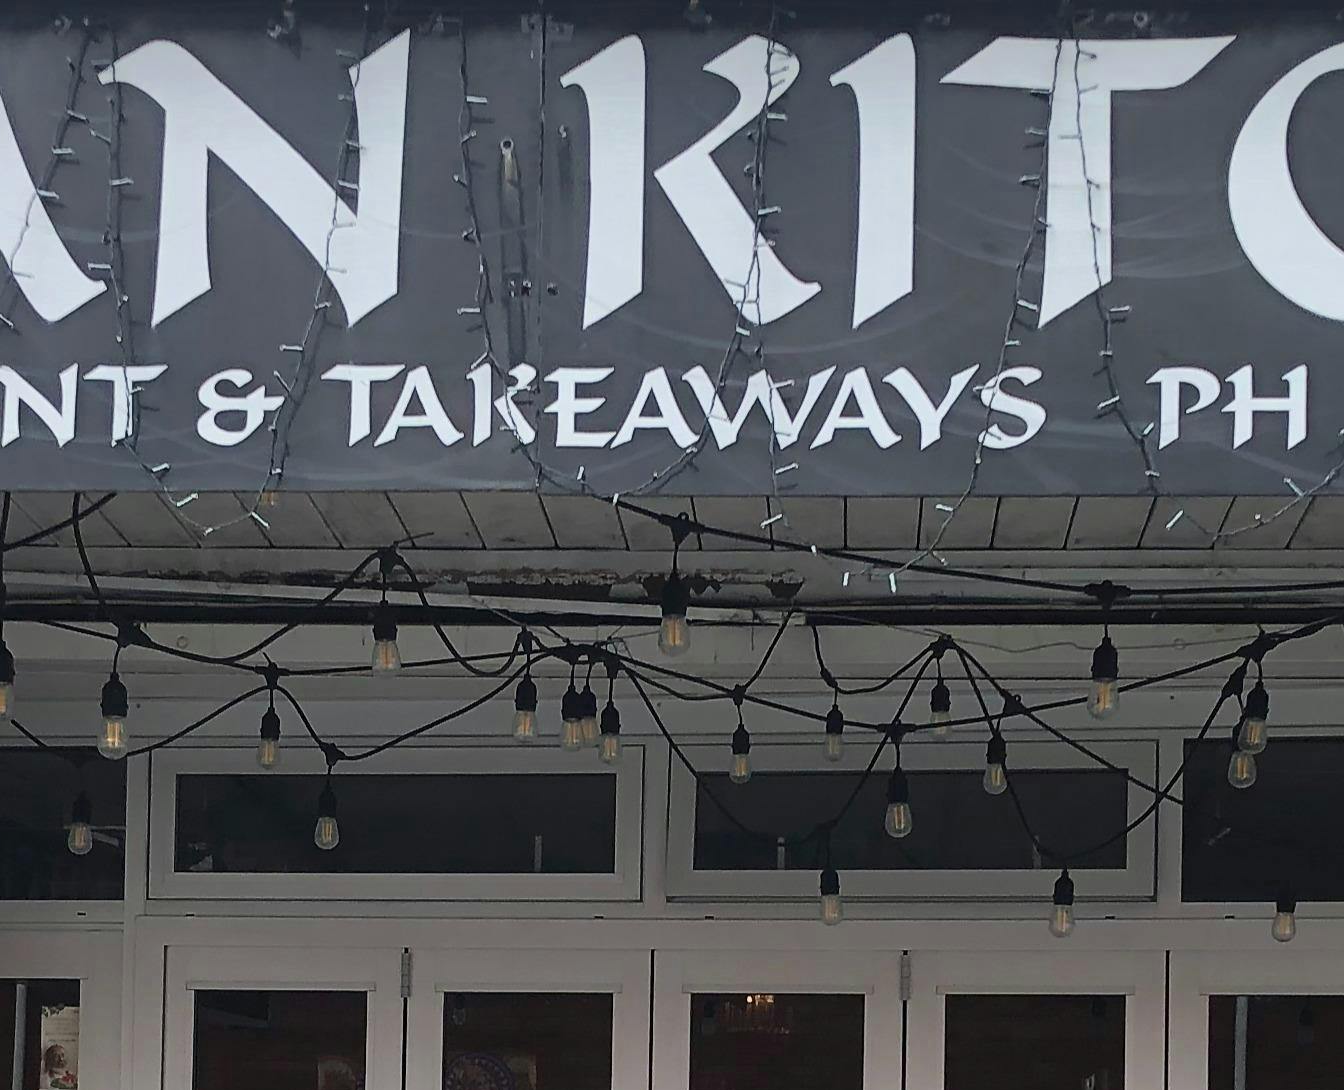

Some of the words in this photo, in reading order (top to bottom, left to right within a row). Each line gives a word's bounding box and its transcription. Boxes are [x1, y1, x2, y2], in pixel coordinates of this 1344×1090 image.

[196, 367, 286, 449] &
[321, 363, 1047, 451] TAKEAWAYS
[1146, 363, 1309, 450] PH
